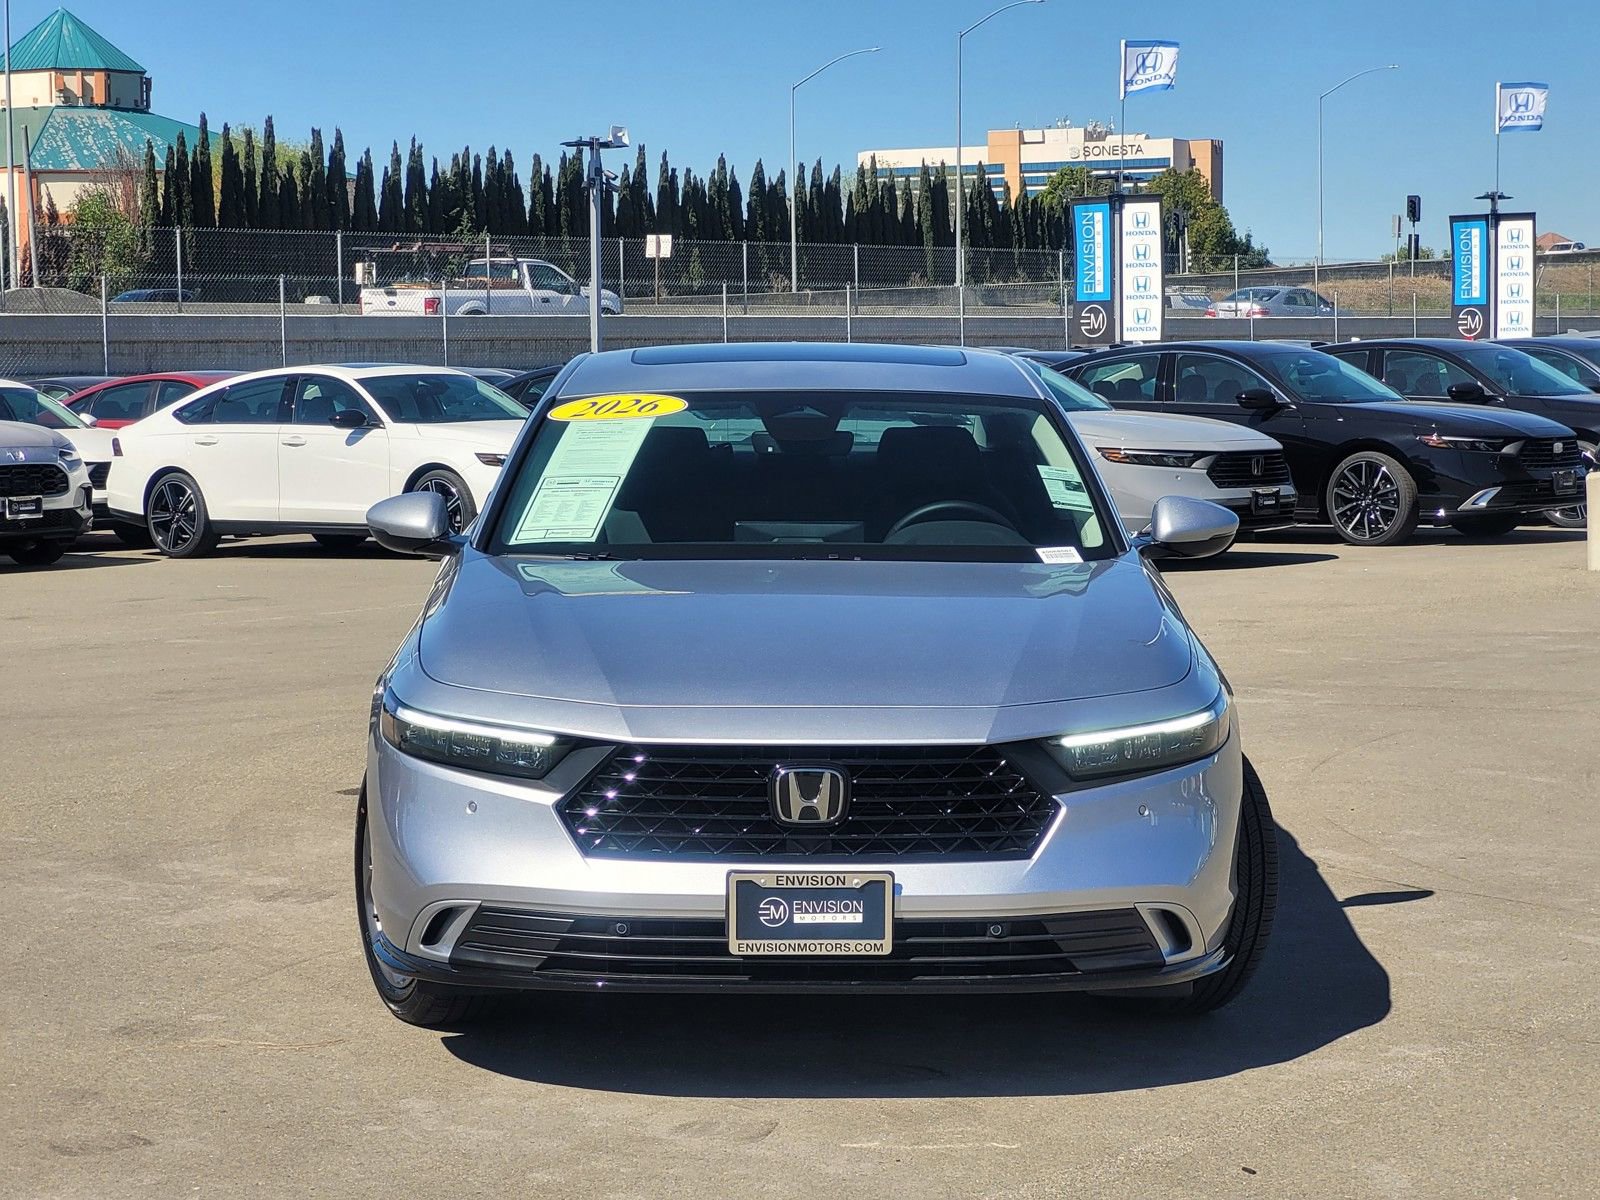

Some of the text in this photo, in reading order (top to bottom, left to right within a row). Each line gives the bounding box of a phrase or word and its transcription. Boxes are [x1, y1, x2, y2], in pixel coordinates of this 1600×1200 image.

[1082, 144, 1144, 158] SONESTA
[1083, 212, 1094, 294] ENVISION
[1461, 228, 1472, 299] ENVISION
[570, 397, 669, 418] 2026
[776, 875, 846, 886] ENVISION
[793, 900, 863, 913] ENVISION
[737, 942, 884, 953] ENVISIONMOTORS.COM
